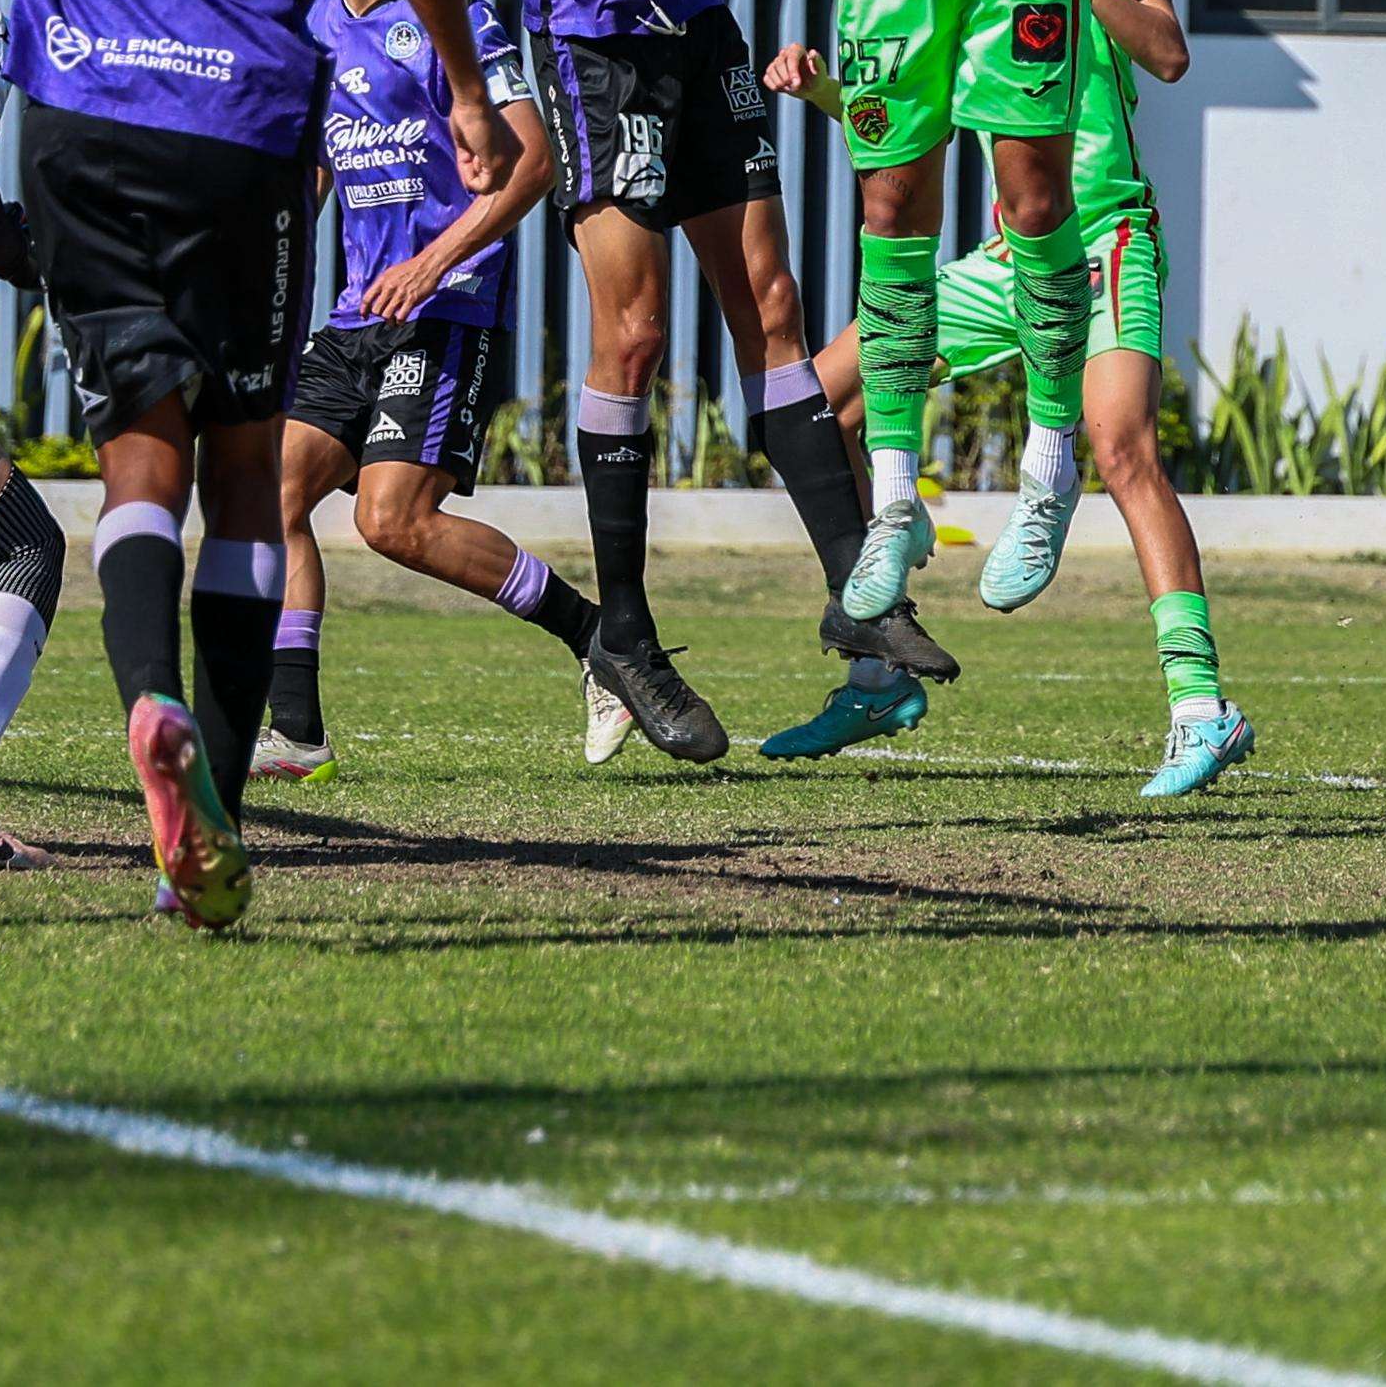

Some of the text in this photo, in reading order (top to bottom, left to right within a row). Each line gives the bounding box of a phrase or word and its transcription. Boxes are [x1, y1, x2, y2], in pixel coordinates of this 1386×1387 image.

[95, 37, 235, 65] EL ENCANTO
[102, 50, 232, 81] DESARROLLOS
[839, 36, 908, 87] 257
[618, 113, 663, 153] 196
[270, 238, 289, 344] GRUPO STI
[467, 354, 487, 405] GRUPO
